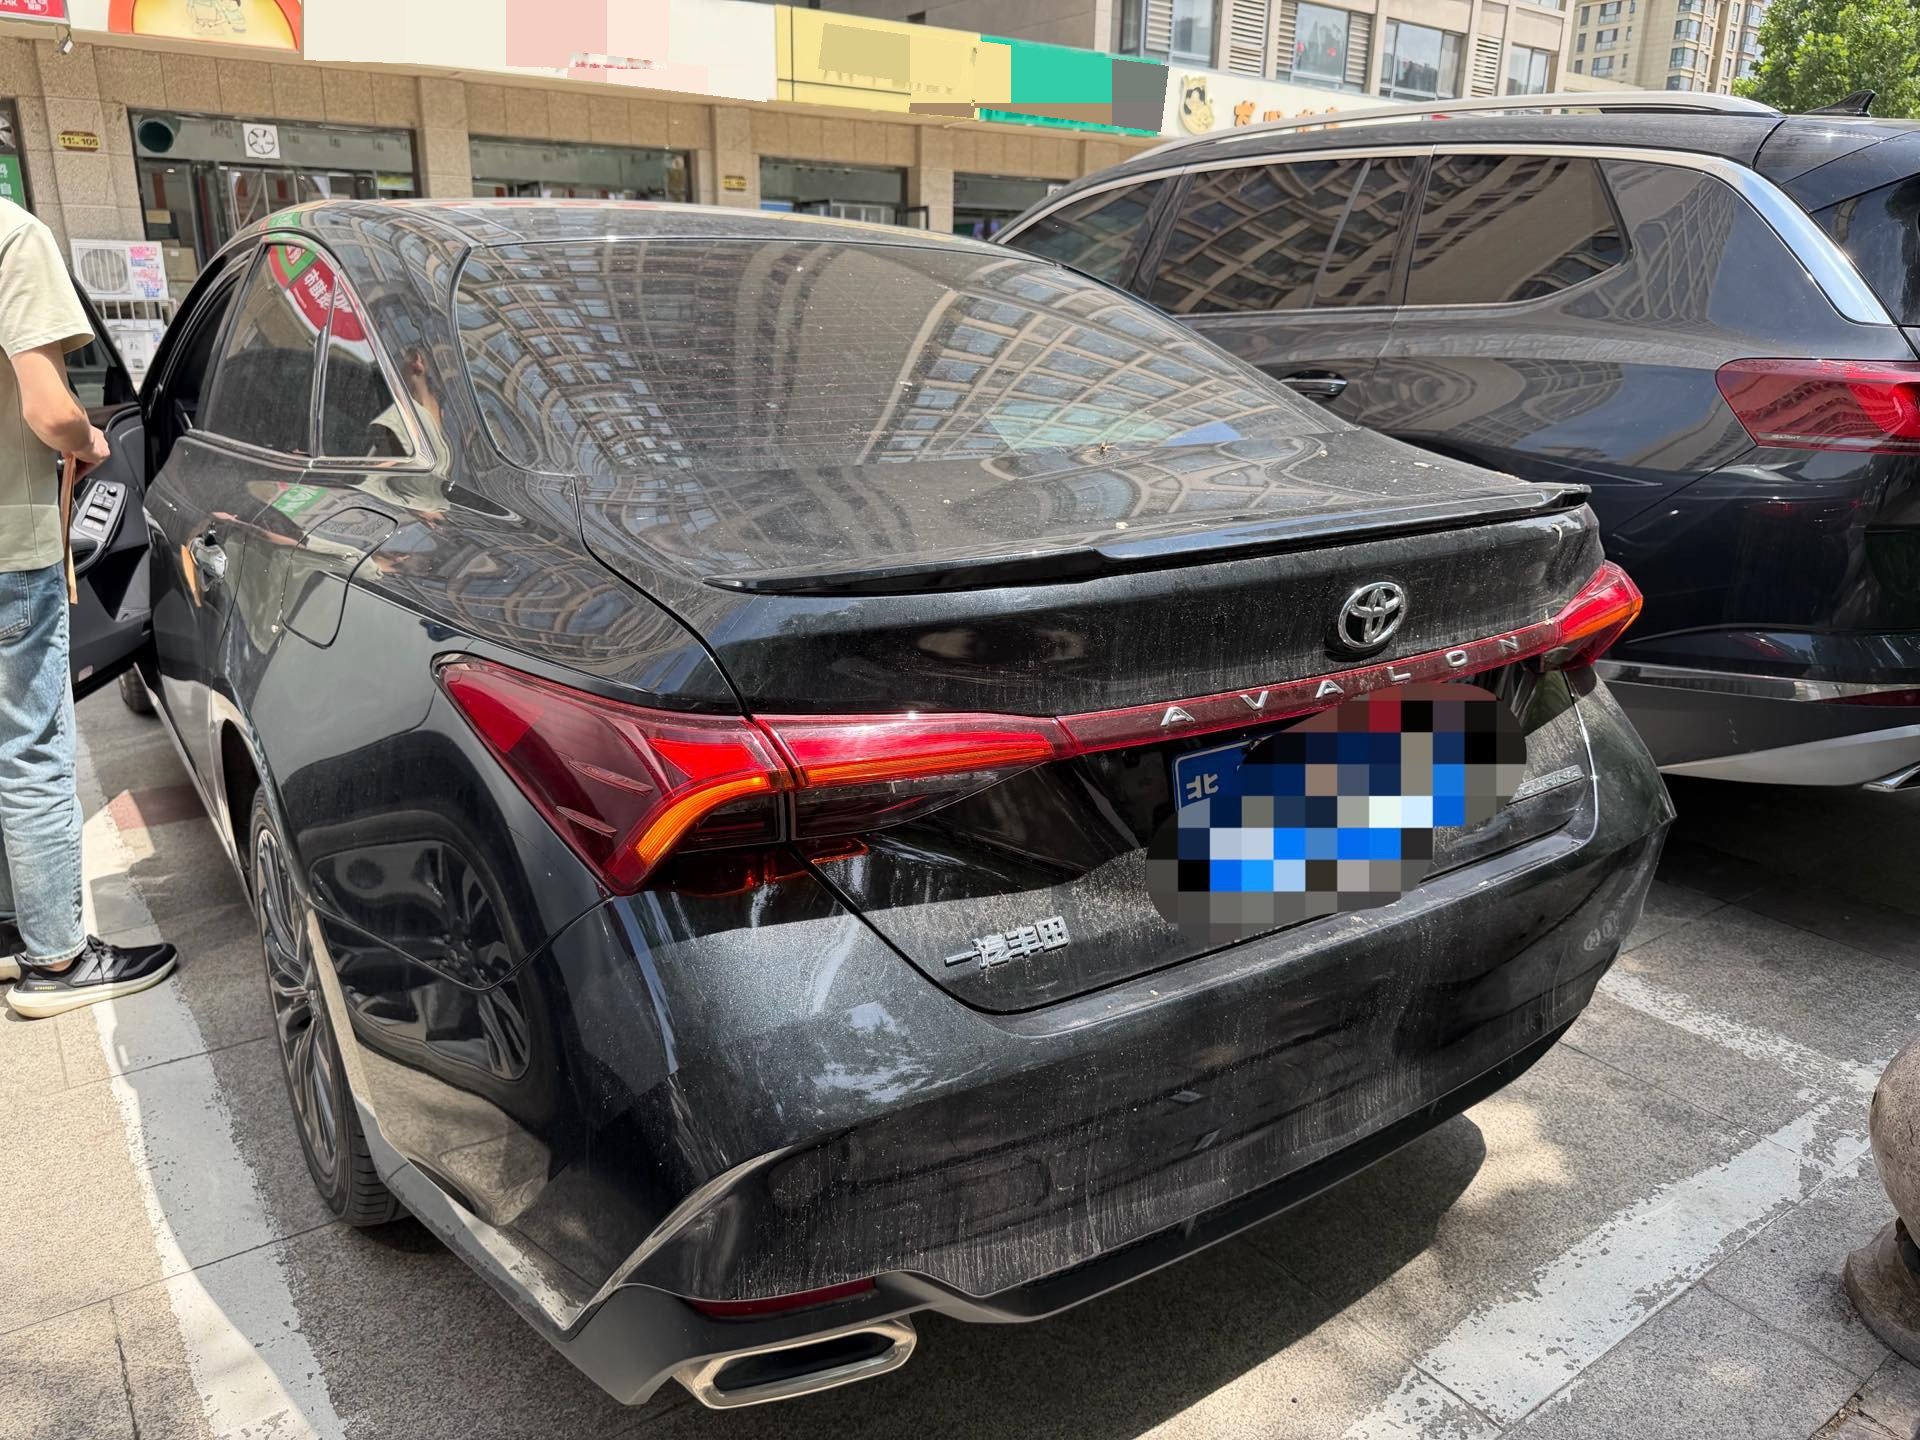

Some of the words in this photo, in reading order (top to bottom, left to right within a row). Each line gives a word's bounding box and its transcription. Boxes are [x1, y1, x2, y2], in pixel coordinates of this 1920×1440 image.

[1160, 636, 1520, 727] AVALON
[1511, 766, 1583, 802] OURING
[944, 916, 1070, 969] 一汽丰田
